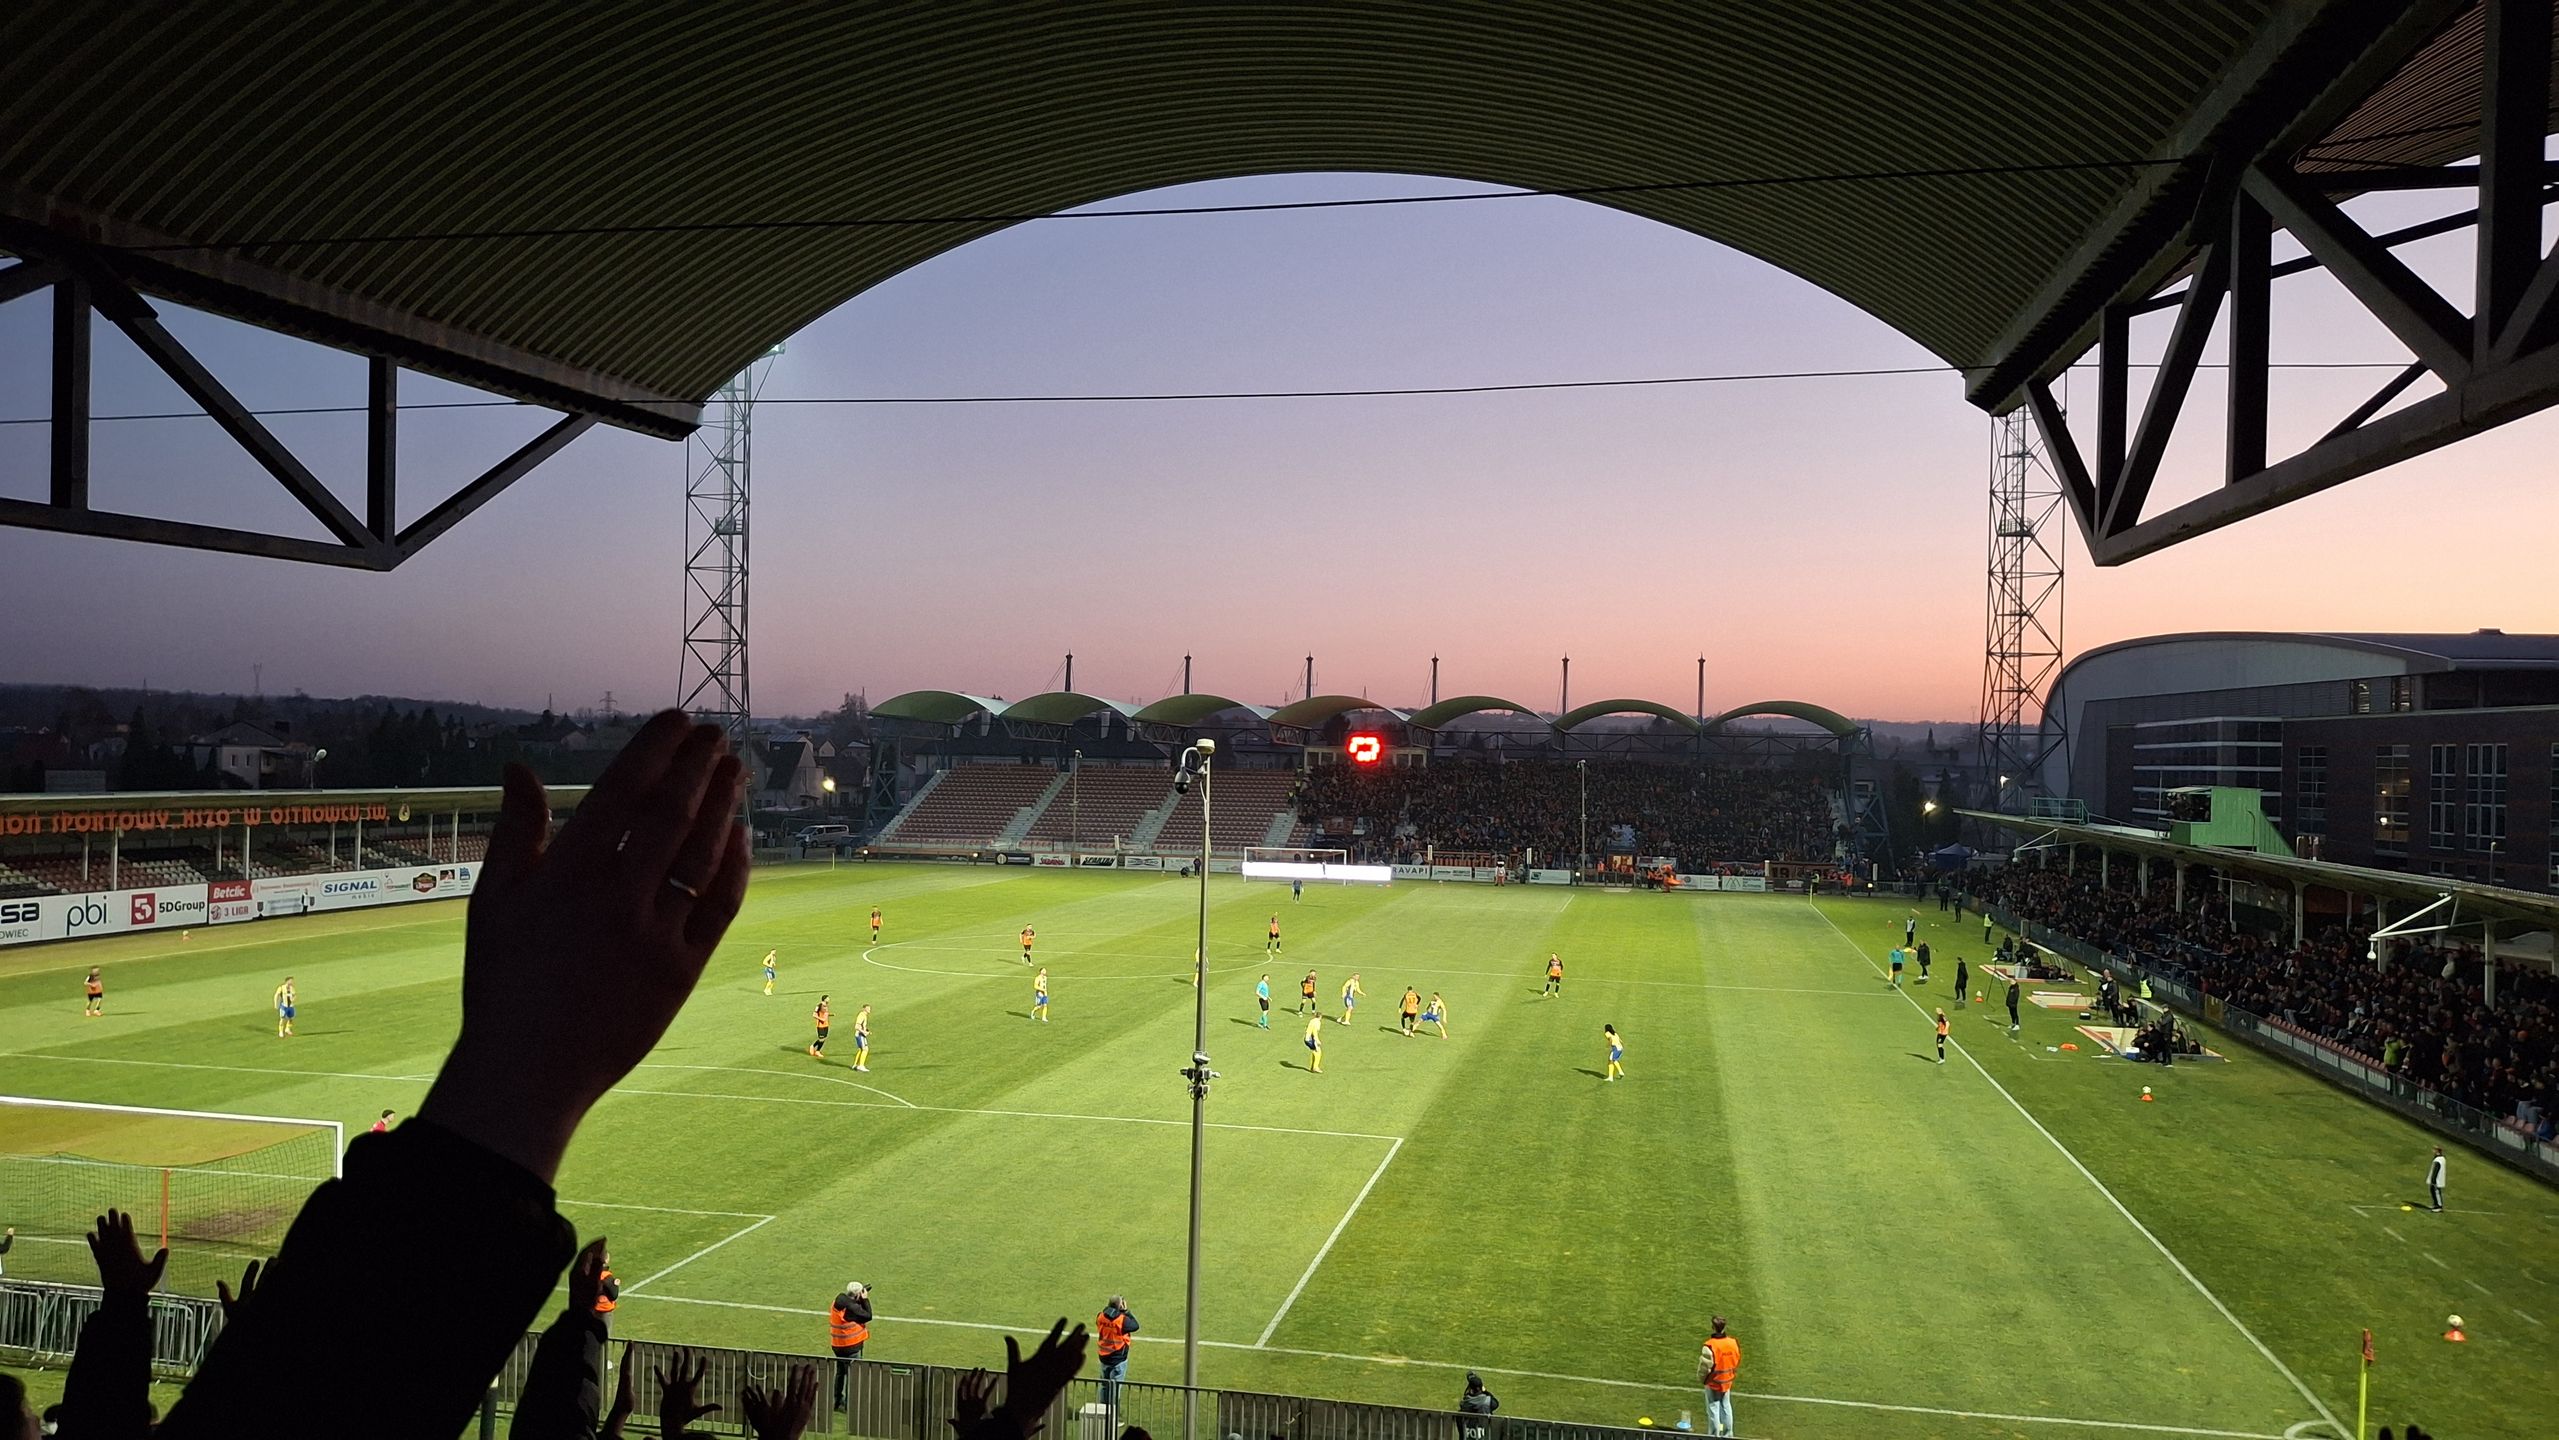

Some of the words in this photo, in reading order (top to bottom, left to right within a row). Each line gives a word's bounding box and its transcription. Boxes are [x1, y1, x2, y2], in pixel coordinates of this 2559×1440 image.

[53, 810, 169, 832] SPORTOWY
[243, 807, 261, 825] W
[213, 887, 246, 899] Betclic
[323, 881, 377, 893] SIGNAL
[159, 901, 205, 913] 5DGroup
